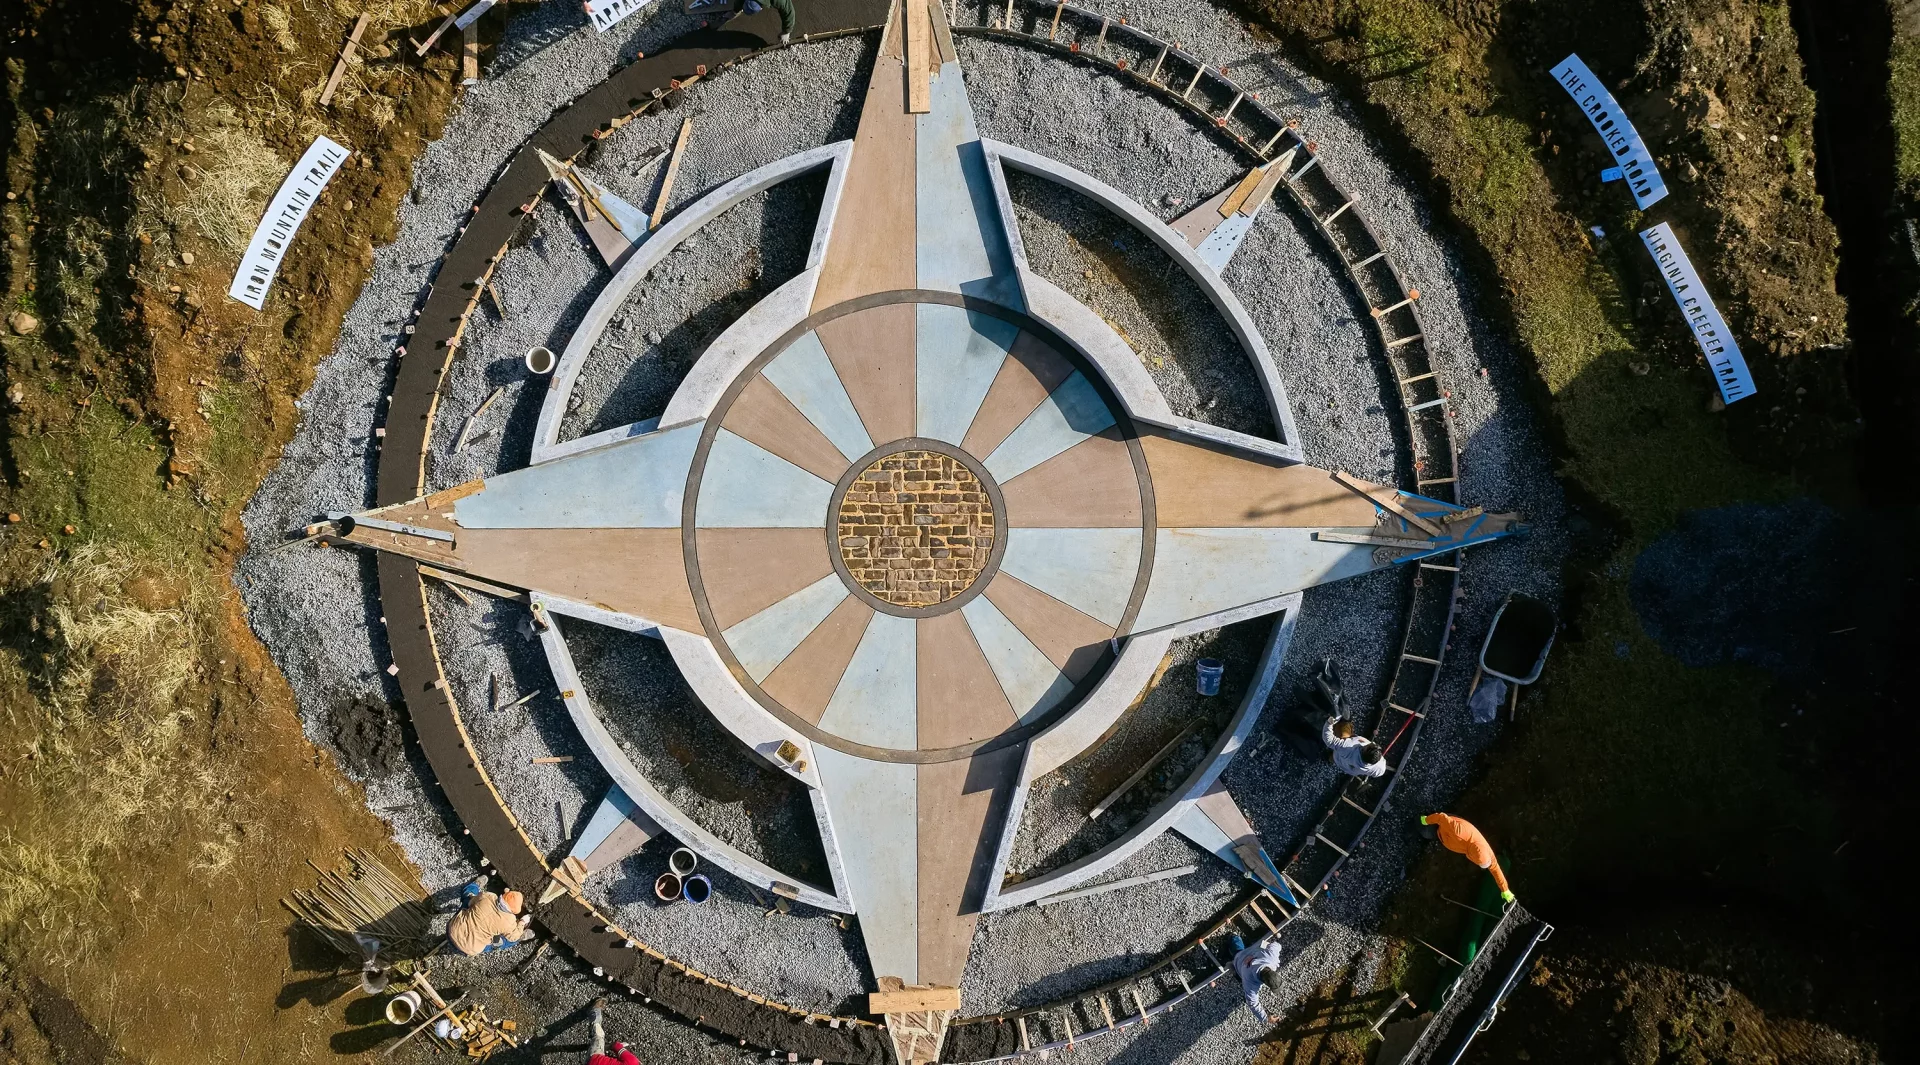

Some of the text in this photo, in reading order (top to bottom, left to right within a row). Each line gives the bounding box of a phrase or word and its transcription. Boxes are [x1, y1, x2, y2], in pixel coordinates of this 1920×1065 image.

[1560, 67, 1653, 199] THE CROOKED ROAD
[243, 147, 342, 301] IRON MOUNTAIN TRAIL
[1645, 227, 1745, 400] VIRGINIA CREEPER TRAIL
